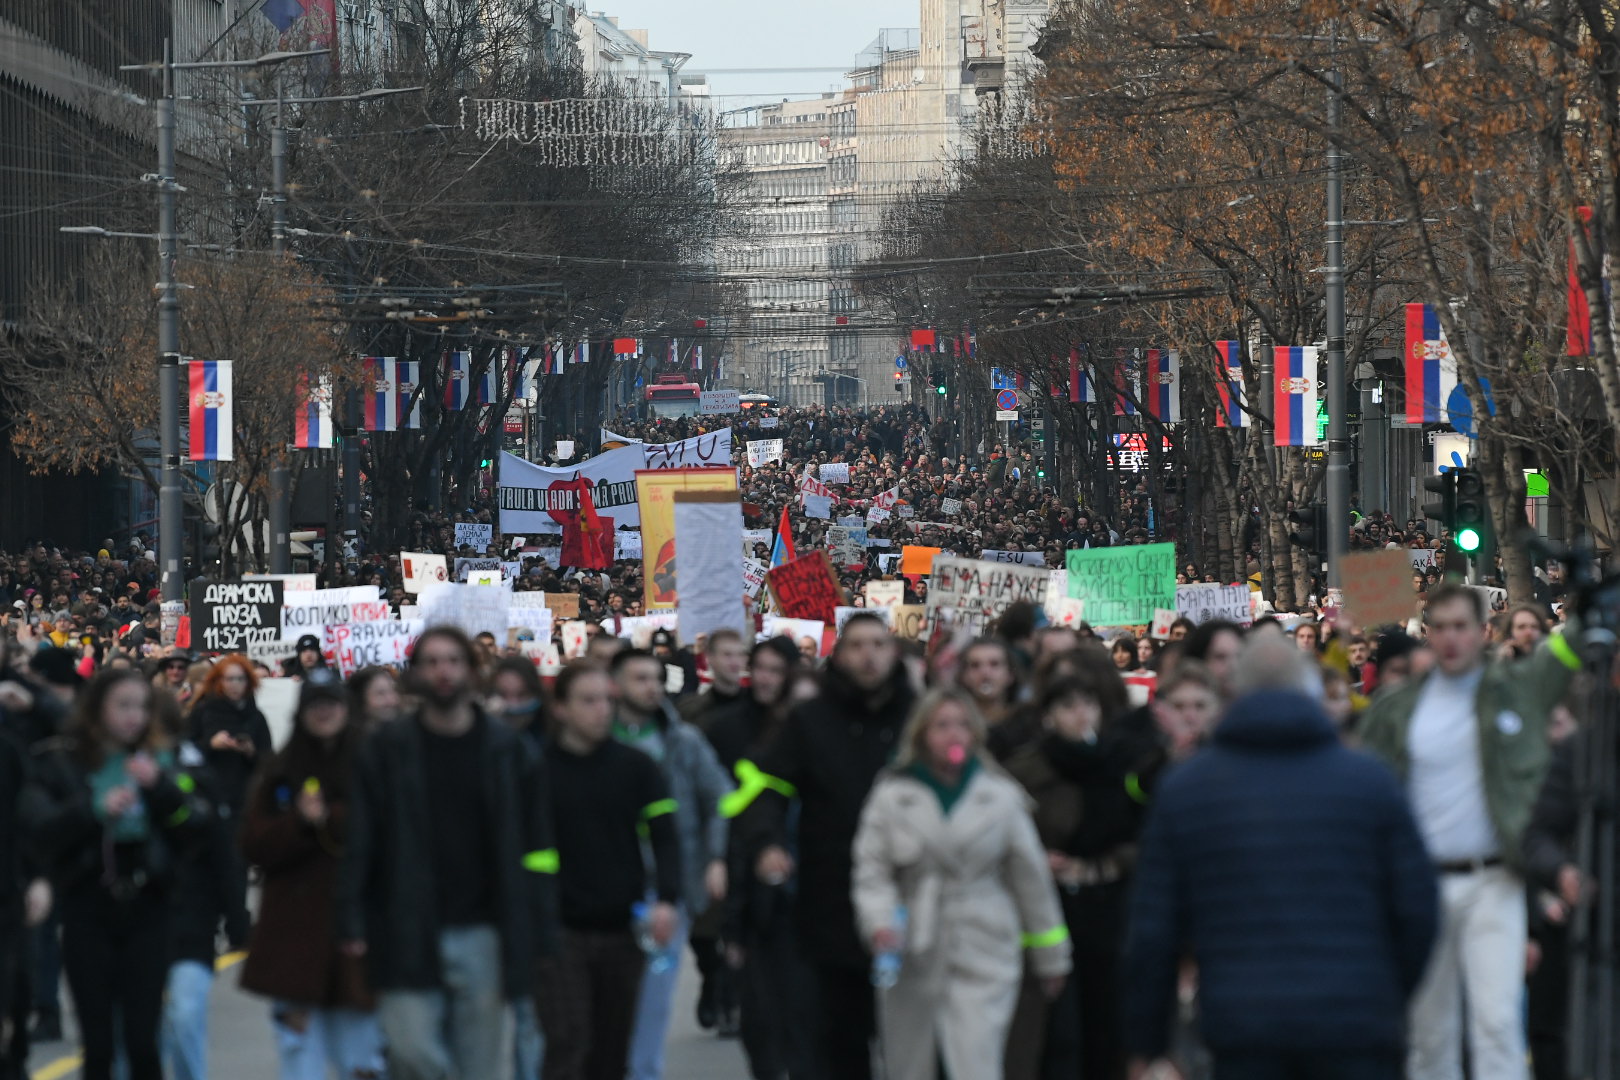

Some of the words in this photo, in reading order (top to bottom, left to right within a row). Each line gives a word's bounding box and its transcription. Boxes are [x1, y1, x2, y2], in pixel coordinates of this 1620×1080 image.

[696, 434, 718, 461] U
[501, 487, 534, 510] TRULA
[536, 488, 574, 511] VLADA
[996, 552, 1024, 564] FSU
[203, 583, 275, 604] ДРАМСКА
[212, 604, 262, 625] ПАУЗА
[284, 604, 350, 627] КОЛИКО
